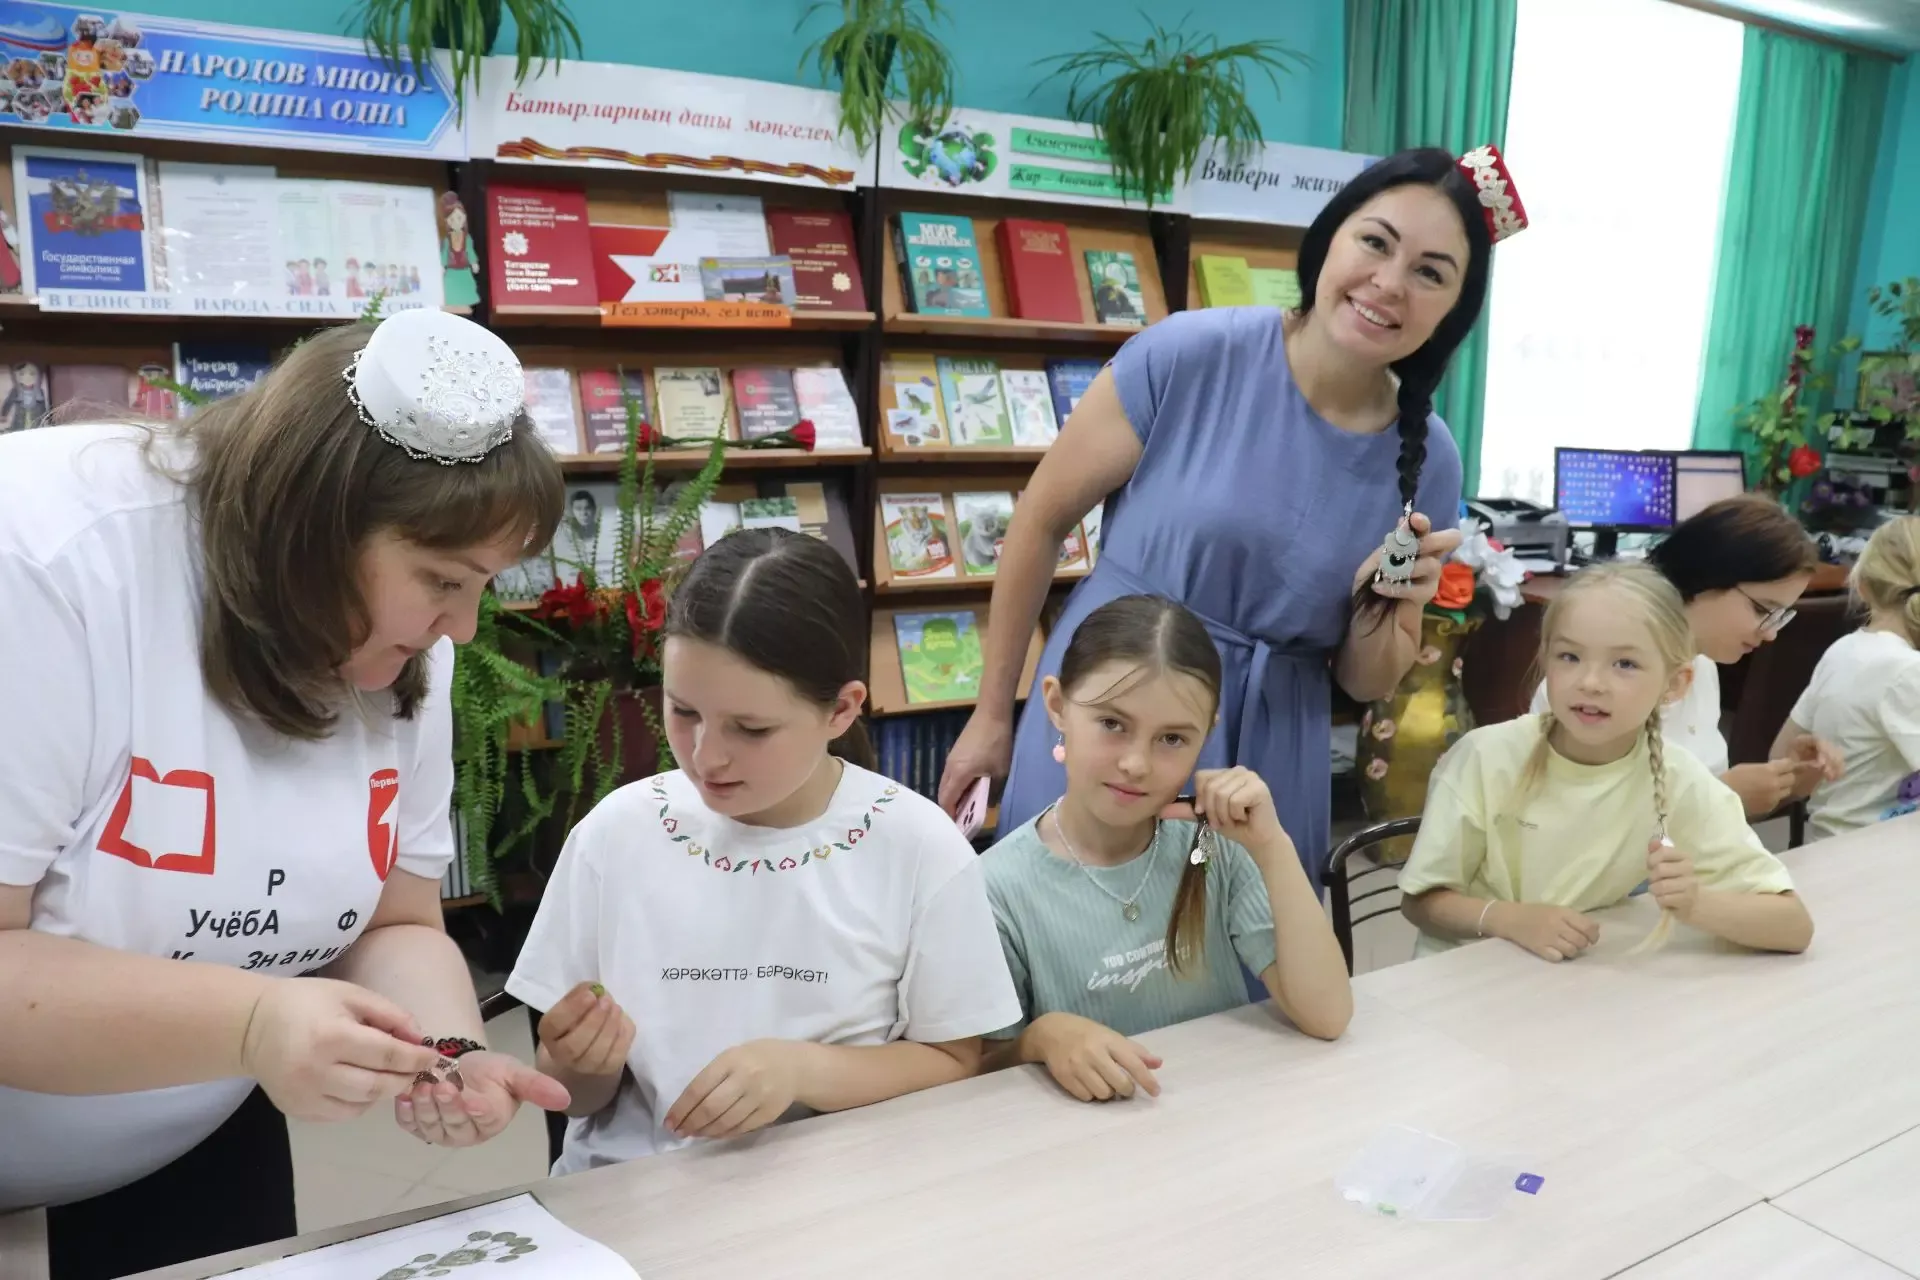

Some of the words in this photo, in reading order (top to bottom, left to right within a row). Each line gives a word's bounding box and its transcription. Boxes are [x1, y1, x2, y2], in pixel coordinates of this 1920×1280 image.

[158, 49, 307, 86] НАРОДОВ
[312, 65, 417, 96] МНОГО
[200, 87, 324, 120] РОДИНА
[331, 99, 407, 127] ОДНА
[1200, 158, 1280, 192] Выбери
[1291, 175, 1347, 194] жизн
[194, 298, 270, 313] НАРОДА
[286, 301, 336, 313] СИЛА
[267, 869, 285, 896] Р
[185, 908, 279, 938] УчёбА
[337, 908, 358, 932] Ф
